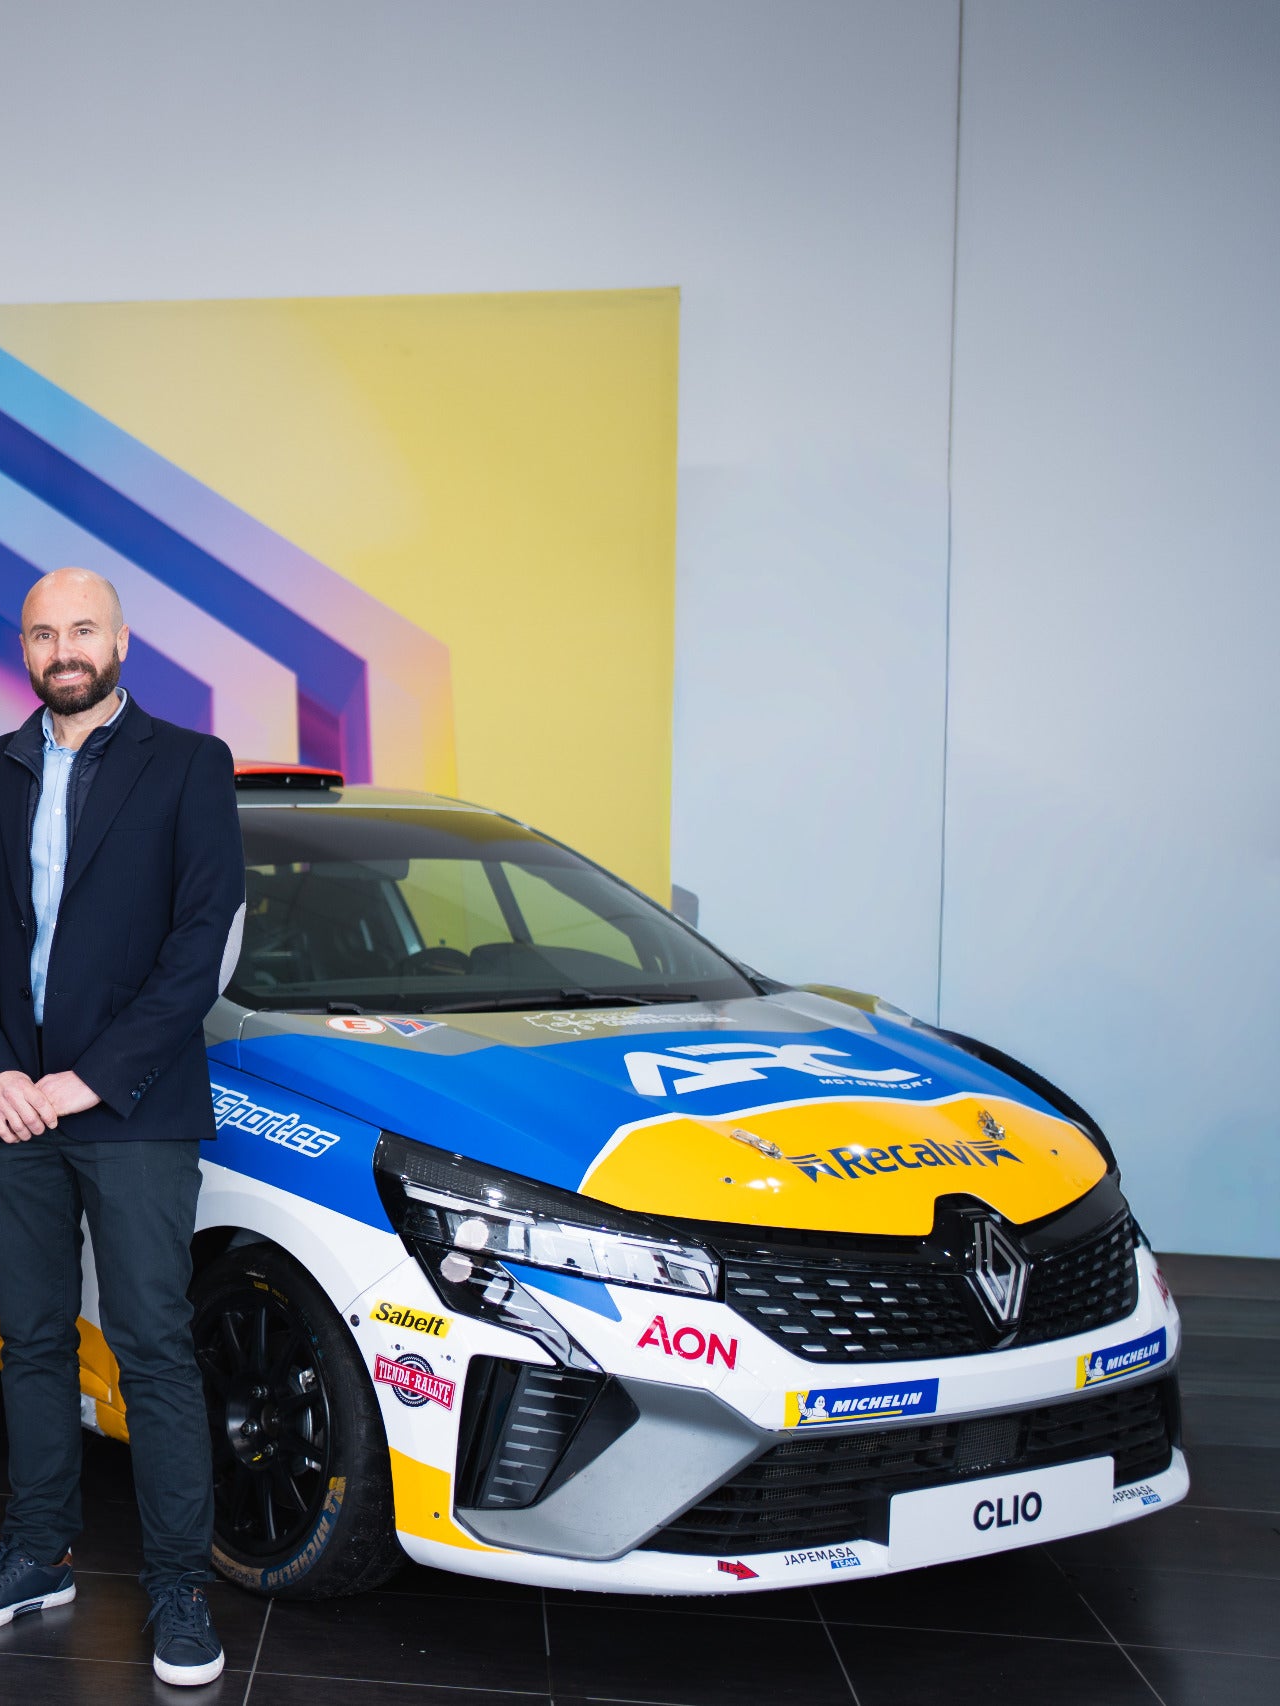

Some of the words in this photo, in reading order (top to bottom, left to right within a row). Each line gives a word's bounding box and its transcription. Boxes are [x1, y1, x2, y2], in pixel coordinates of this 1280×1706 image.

[818, 1077, 933, 1090] MOTORSPORT
[827, 1138, 988, 1179] Recalvi
[375, 1302, 444, 1336] Sabelt
[636, 1315, 738, 1370] AON
[1106, 1341, 1160, 1371] MICHELIN
[832, 1391, 923, 1413] MICHELIN
[1113, 1484, 1155, 1504] APEMASA
[972, 1491, 1042, 1531] CLIO
[266, 1515, 331, 1587] MICHELIN
[783, 1546, 856, 1566] JAPEMASA
[833, 1557, 859, 1568] TEAM
